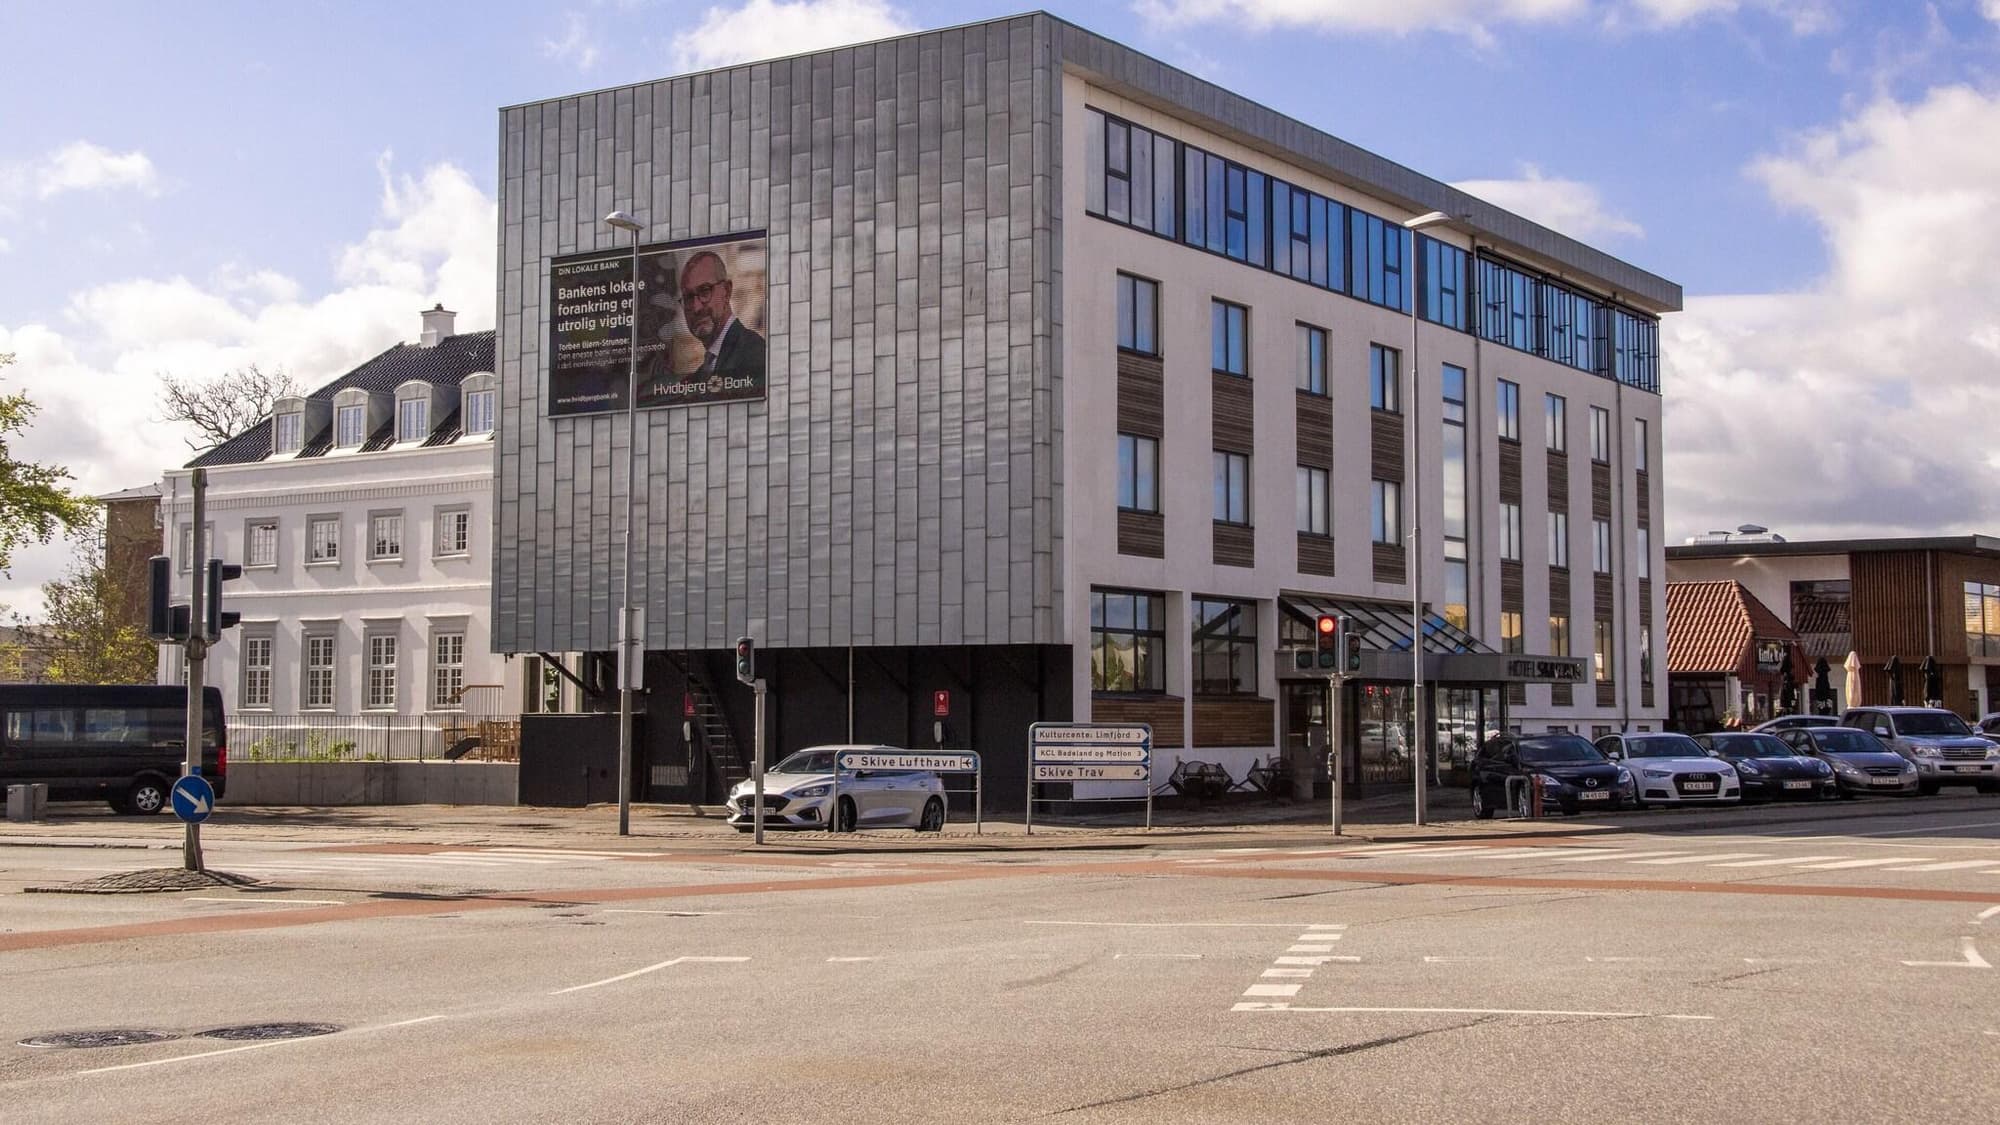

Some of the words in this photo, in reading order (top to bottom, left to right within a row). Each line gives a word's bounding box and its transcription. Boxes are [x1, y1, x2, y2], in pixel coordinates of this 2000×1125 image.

[572, 264, 599, 274] LOKALE
[600, 261, 620, 270] BANK
[558, 285, 606, 300] Bankens
[610, 280, 645, 294] lokae
[558, 300, 618, 316] forankring
[558, 317, 596, 332] utrolig
[654, 381, 706, 396] Hvidbjerg
[724, 375, 754, 389] Bank
[1096, 730, 1130, 740] Limfjord
[847, 758, 853, 766] 9
[862, 756, 896, 766] Skive
[900, 757, 956, 767] Lufthavn
[1040, 768, 1074, 776] Skive
[1078, 768, 1104, 776] Trav
